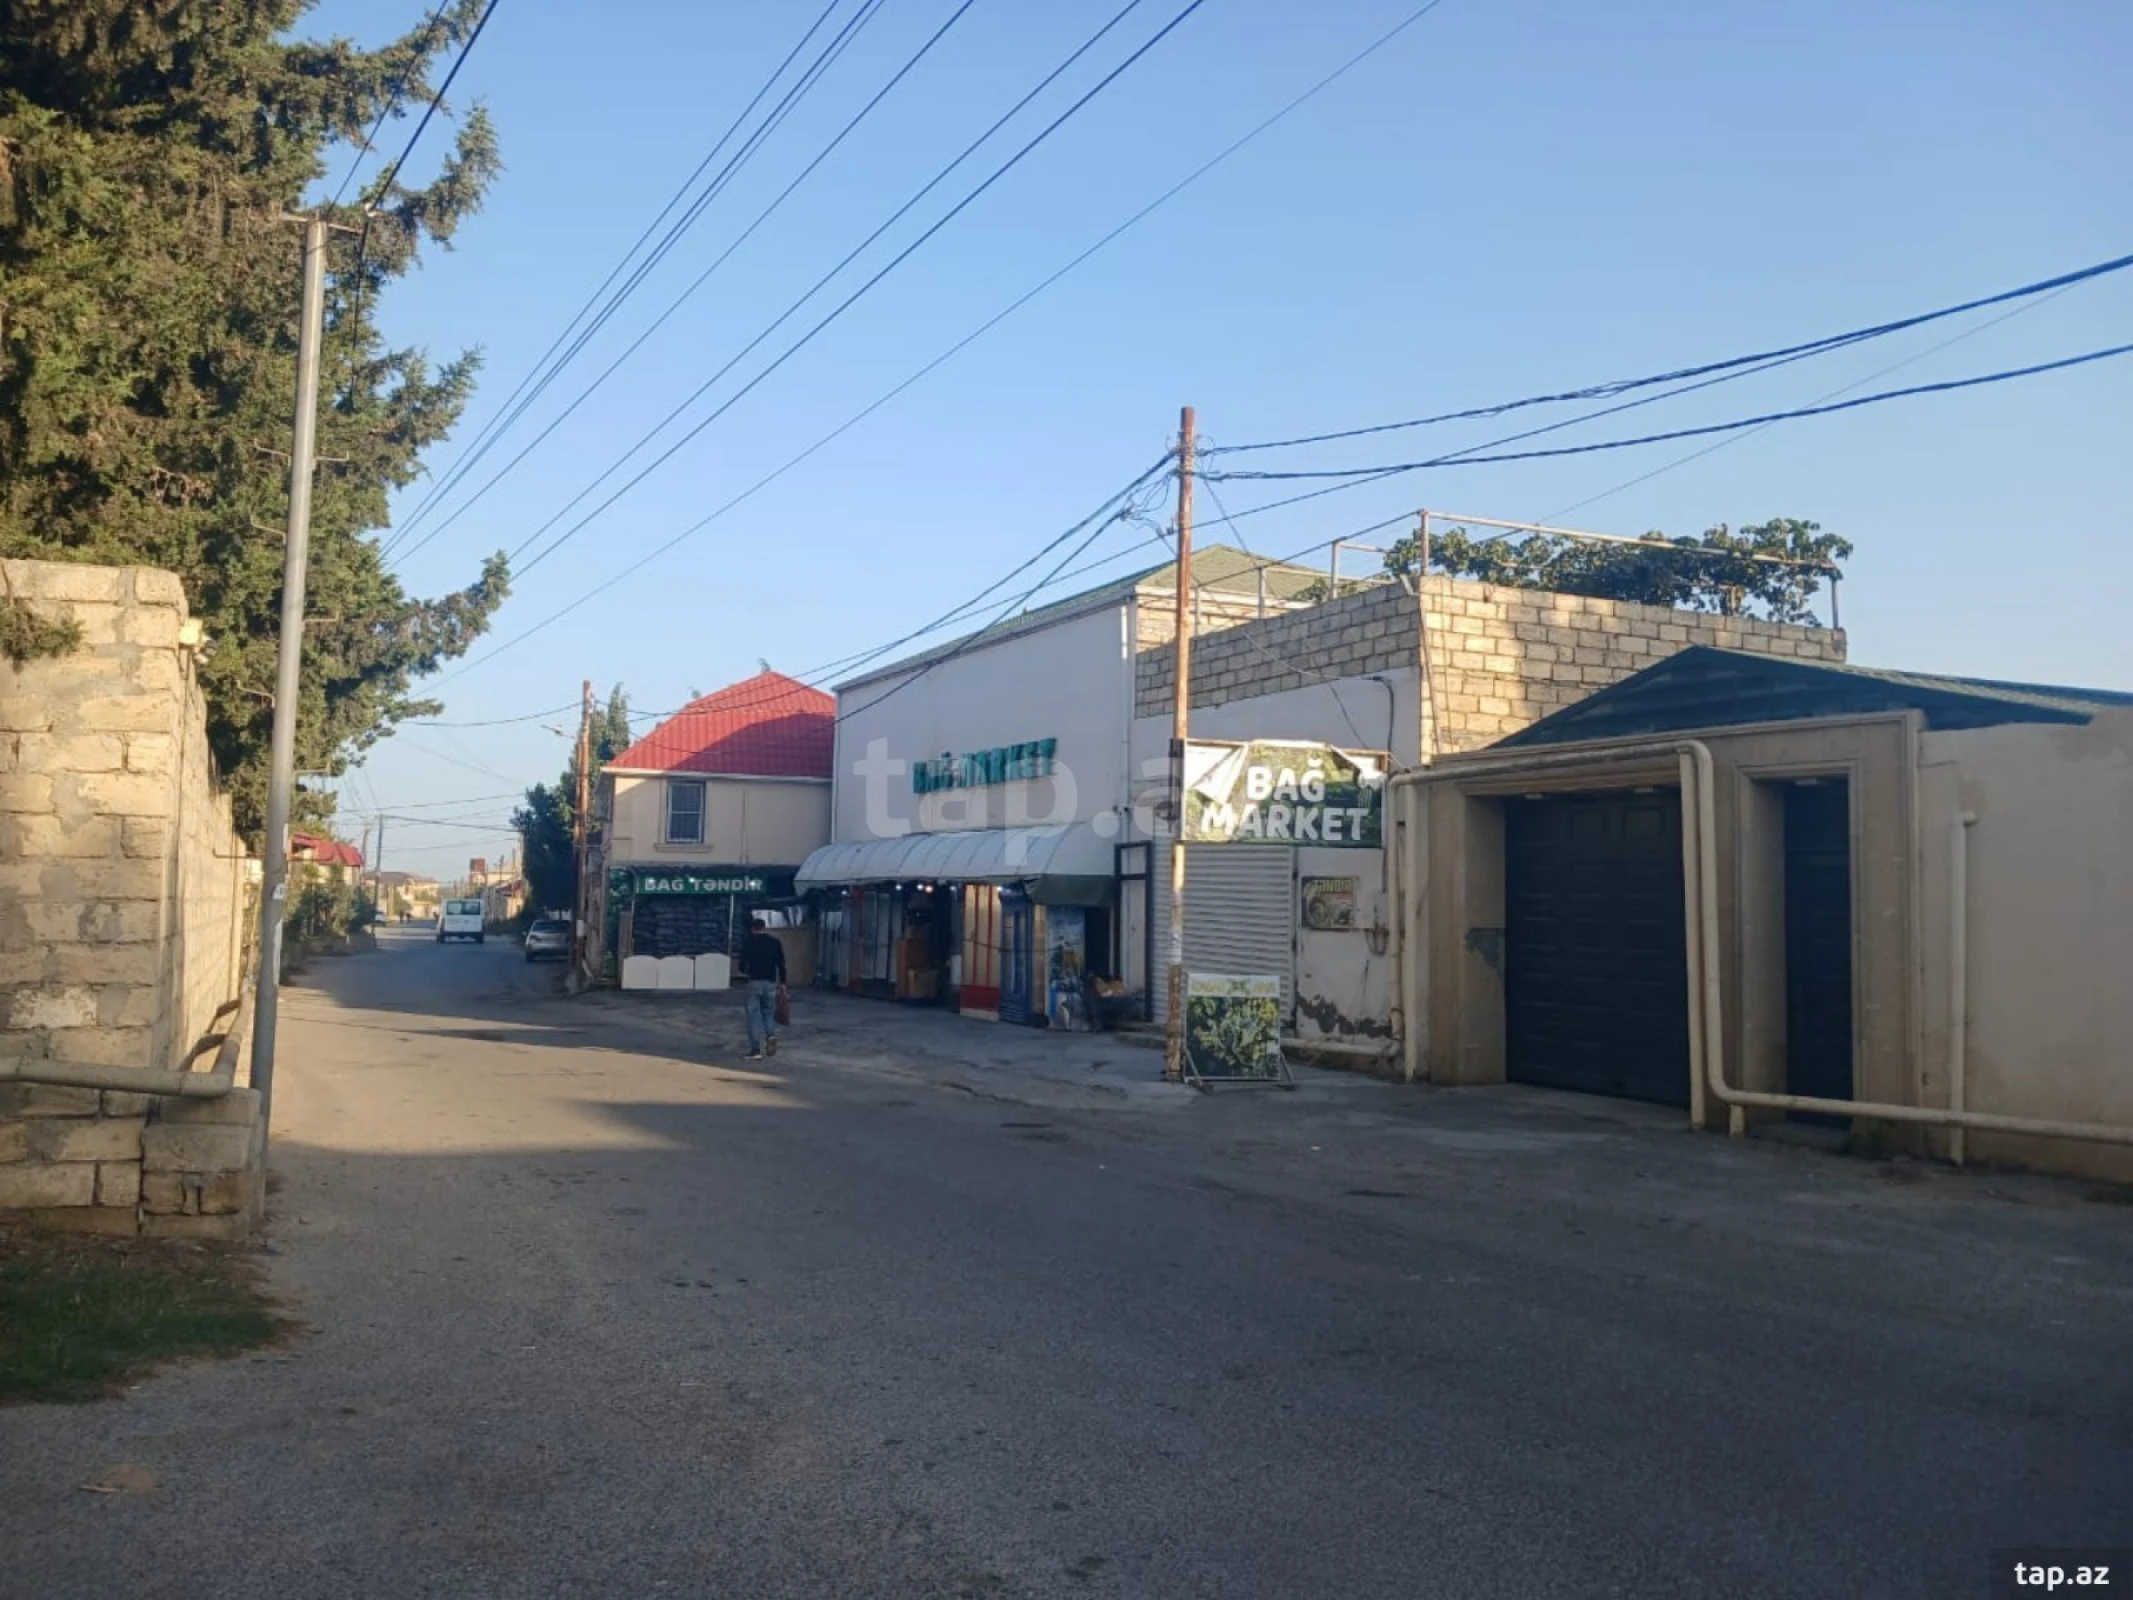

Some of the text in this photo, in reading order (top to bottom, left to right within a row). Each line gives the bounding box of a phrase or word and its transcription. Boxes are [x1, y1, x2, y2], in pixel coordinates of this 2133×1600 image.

[1246, 757, 1326, 803] BAĞ
[1200, 803, 1370, 841] MARKET
[692, 875, 764, 892] TƏNDİR
